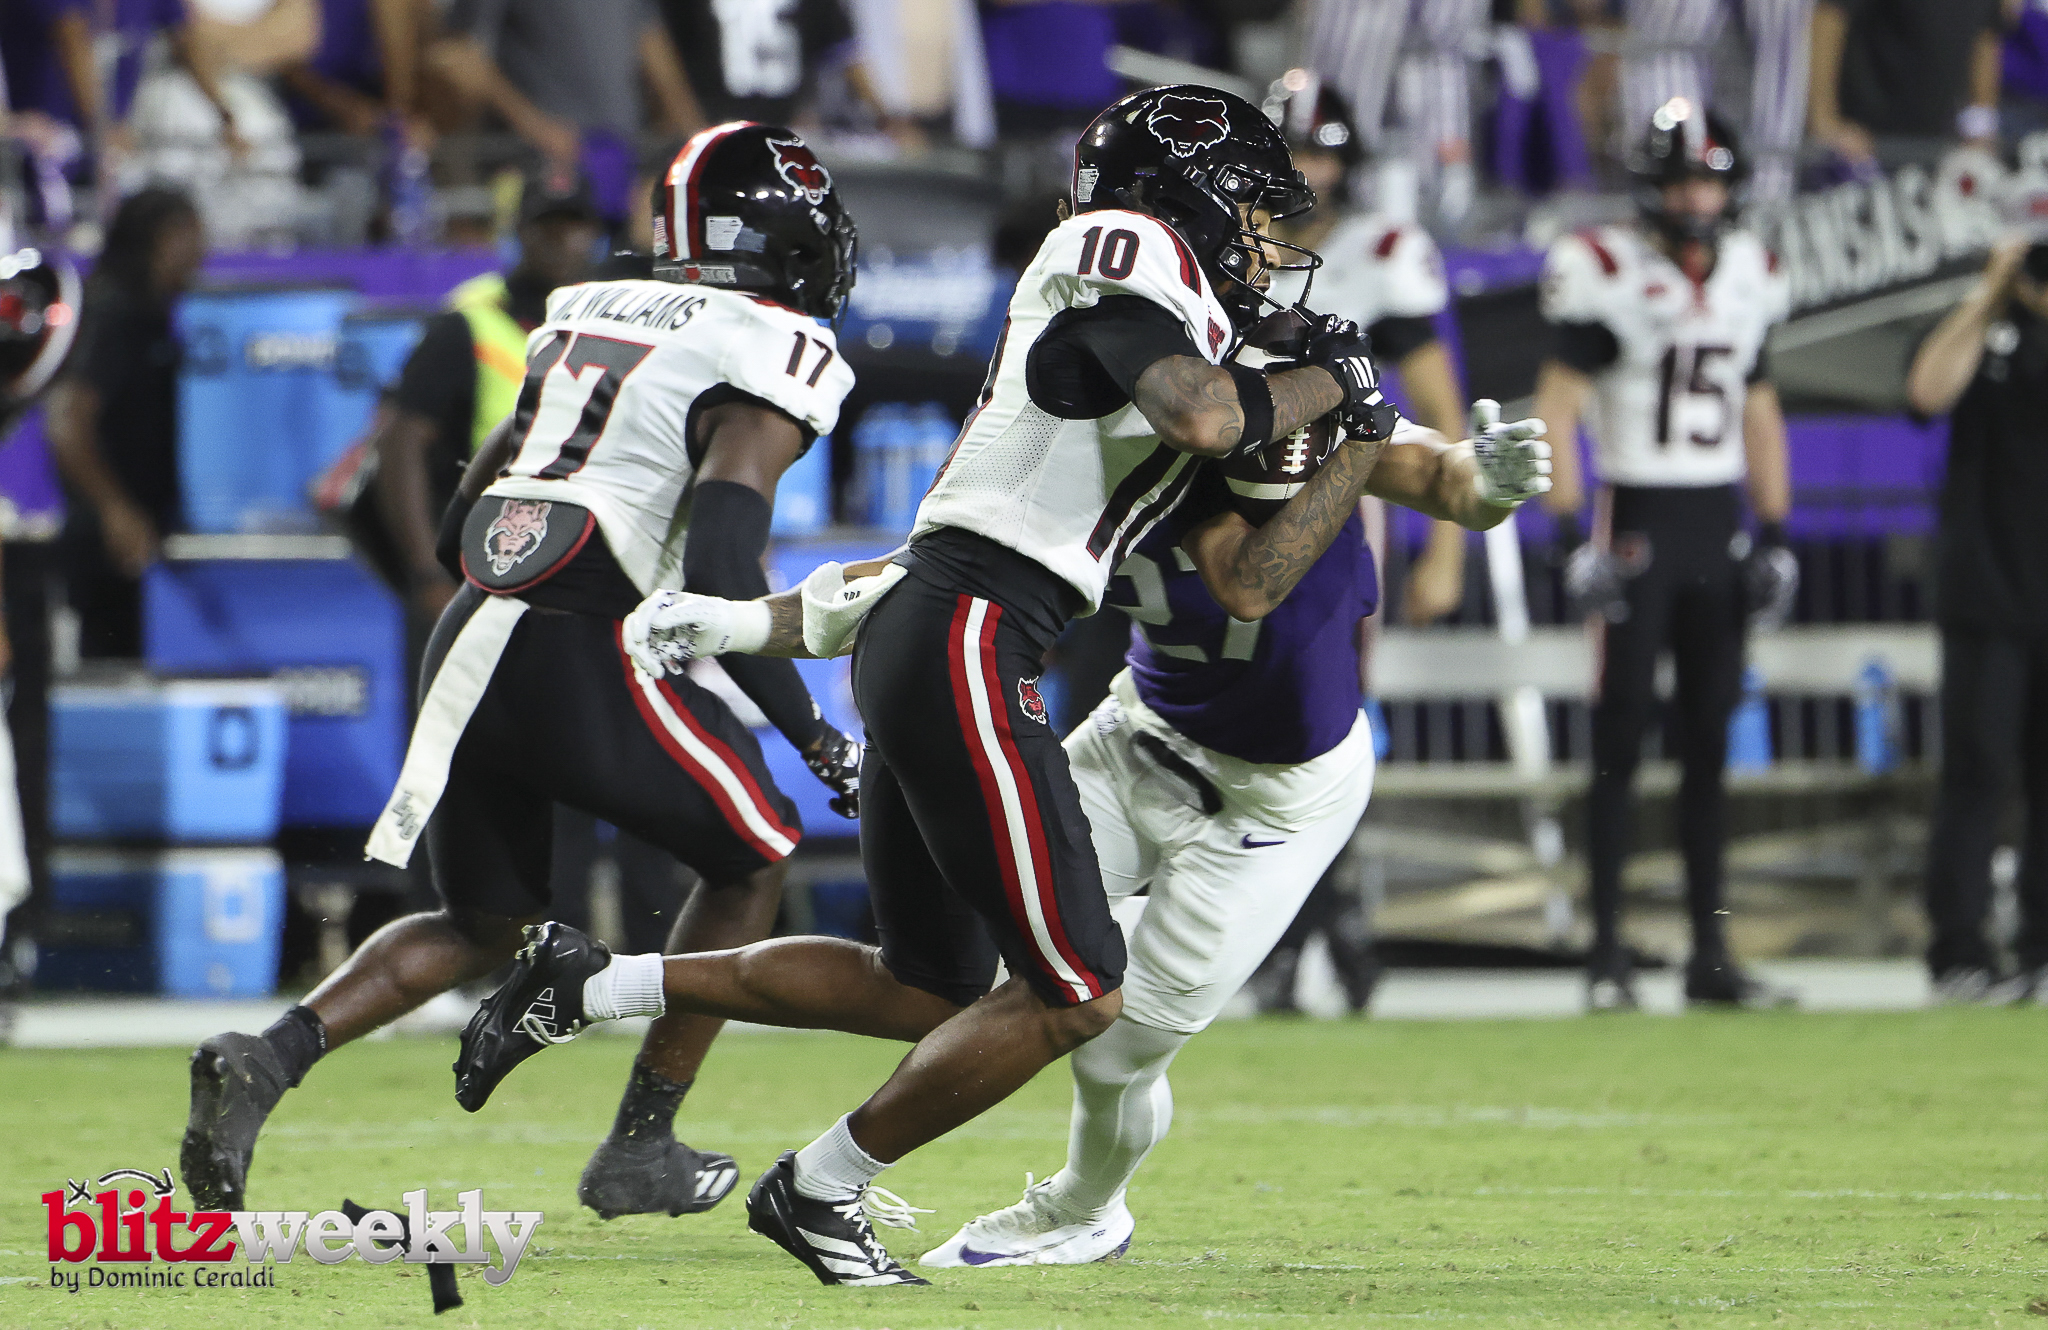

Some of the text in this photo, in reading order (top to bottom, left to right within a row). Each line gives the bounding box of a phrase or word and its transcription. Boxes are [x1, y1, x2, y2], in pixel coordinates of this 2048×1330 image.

[1077, 226, 1140, 281] 10
[577, 286, 707, 331] WILLIAMS
[785, 330, 834, 389] 17
[505, 329, 656, 480] 17
[1654, 343, 1736, 448] 15
